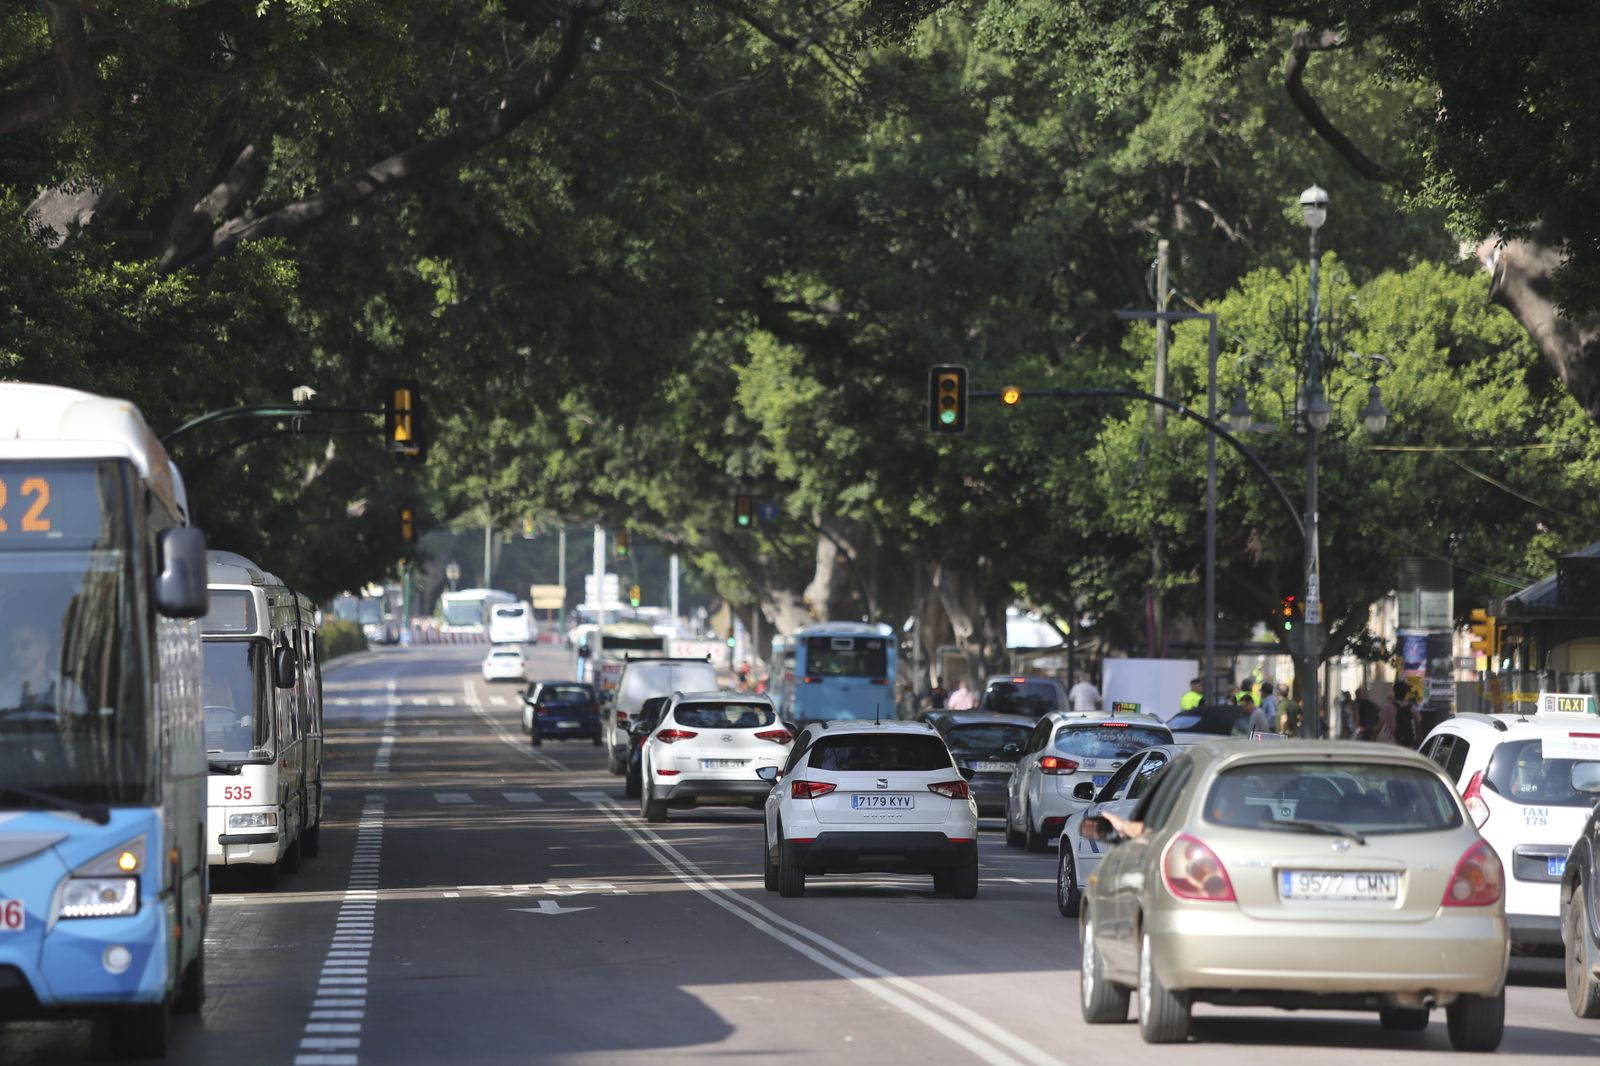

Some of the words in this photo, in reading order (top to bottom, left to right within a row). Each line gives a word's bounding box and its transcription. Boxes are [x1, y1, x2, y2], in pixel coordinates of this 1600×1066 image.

[1558, 698, 1584, 711] TAXI
[224, 785, 252, 800] 535
[859, 796, 887, 807] 7179
[889, 796, 911, 807] KYV
[1522, 807, 1549, 817] TAXI
[1525, 816, 1548, 826] 178
[1299, 874, 1345, 893] 9577
[1355, 875, 1391, 893] CMN
